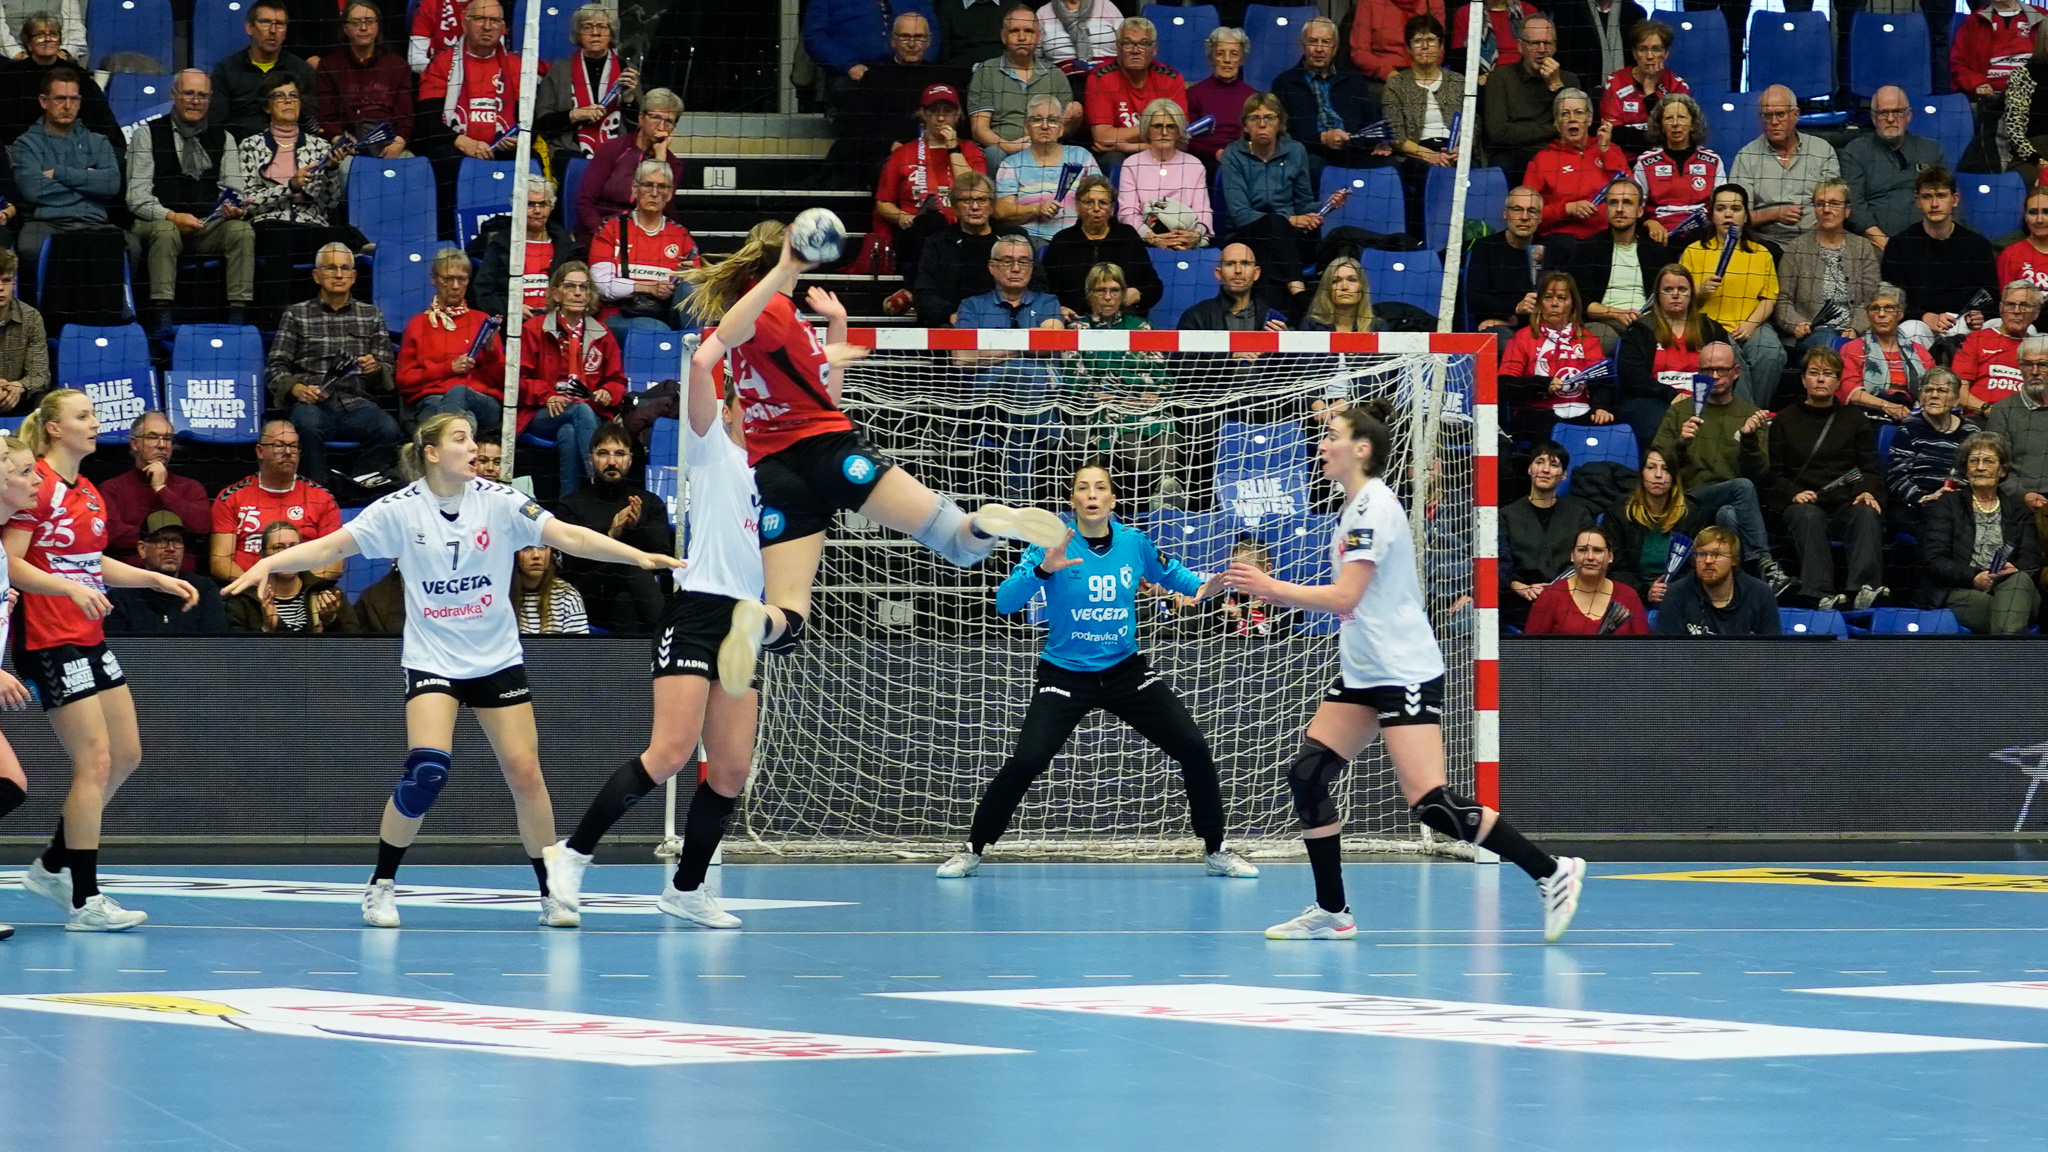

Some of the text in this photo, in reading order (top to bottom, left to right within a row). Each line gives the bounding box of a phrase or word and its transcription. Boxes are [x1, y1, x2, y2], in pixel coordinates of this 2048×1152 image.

[1643, 155, 1664, 166] LOLK
[1697, 154, 1718, 164] LOLK
[713, 169, 725, 187] H
[628, 268, 668, 278] KECHERS
[85, 378, 134, 402] BLUE
[187, 379, 235, 399] BLUE
[179, 399, 246, 418] WATER
[97, 419, 135, 434] HIPPIN
[189, 418, 236, 429] SHIPPING
[1235, 477, 1284, 499] BLUE
[34, 518, 75, 548] 25
[447, 541, 460, 570] 7
[422, 575, 492, 594] VEGETA
[1088, 575, 1117, 602] 98
[423, 603, 482, 618] Podravka
[1070, 607, 1129, 622] VEGETA
[1260, 997, 1748, 1033] Toyota
